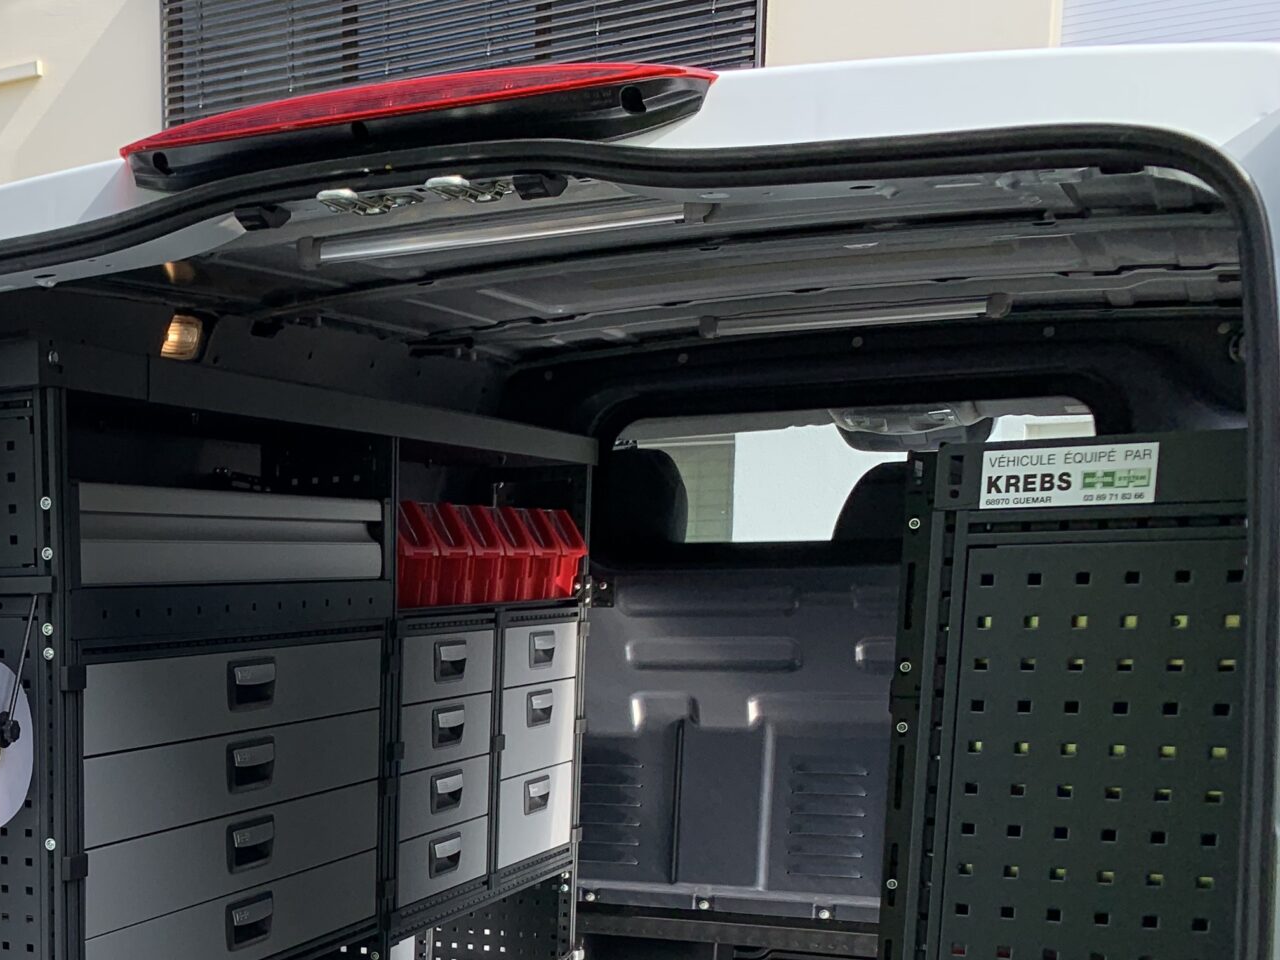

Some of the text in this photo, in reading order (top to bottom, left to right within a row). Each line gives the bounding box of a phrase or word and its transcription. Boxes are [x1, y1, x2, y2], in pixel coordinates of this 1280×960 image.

[989, 449, 1153, 467] VÉHICULE ÉQUIPÉ PAR
[986, 472, 1072, 494] KREBS
[1013, 496, 1052, 504] GUEMAR
